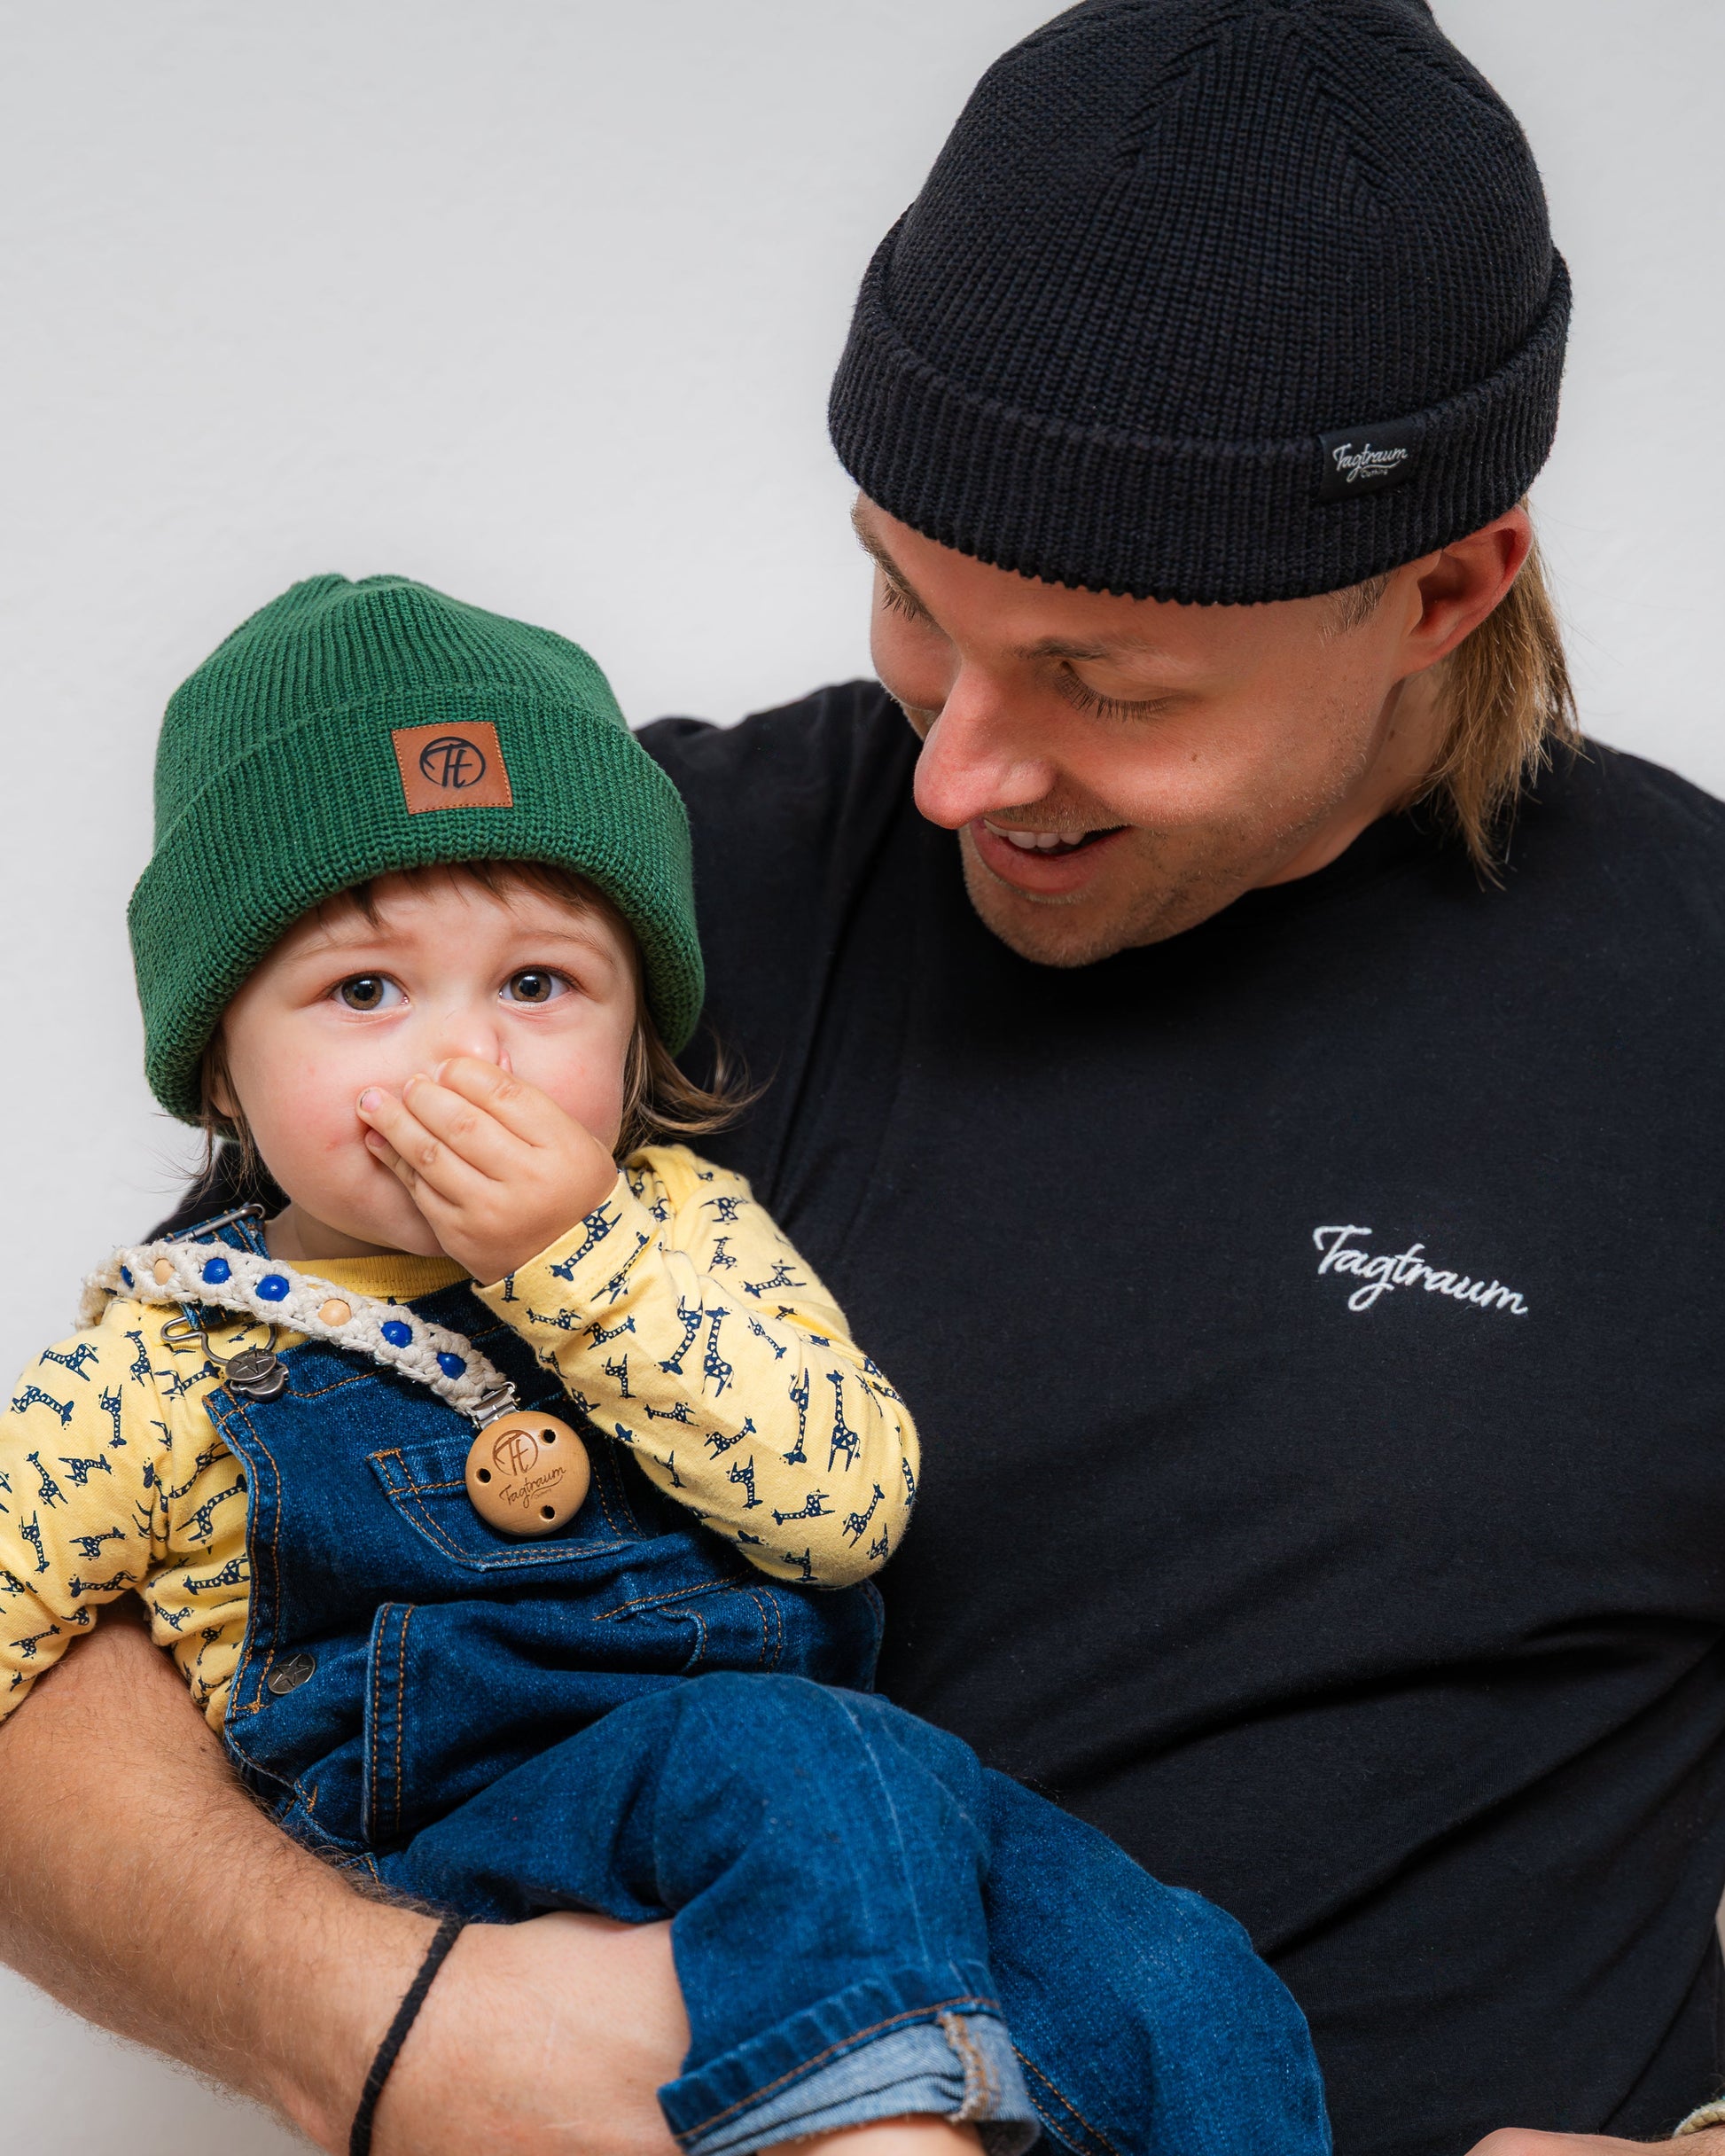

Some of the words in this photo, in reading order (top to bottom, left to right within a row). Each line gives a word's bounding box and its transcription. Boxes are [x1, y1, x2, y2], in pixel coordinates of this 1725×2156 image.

[1332, 443, 1408, 483] Tagtraum
[1313, 1224, 1528, 1315] Tagtraum
[498, 1466, 566, 1509] Tagtraum
